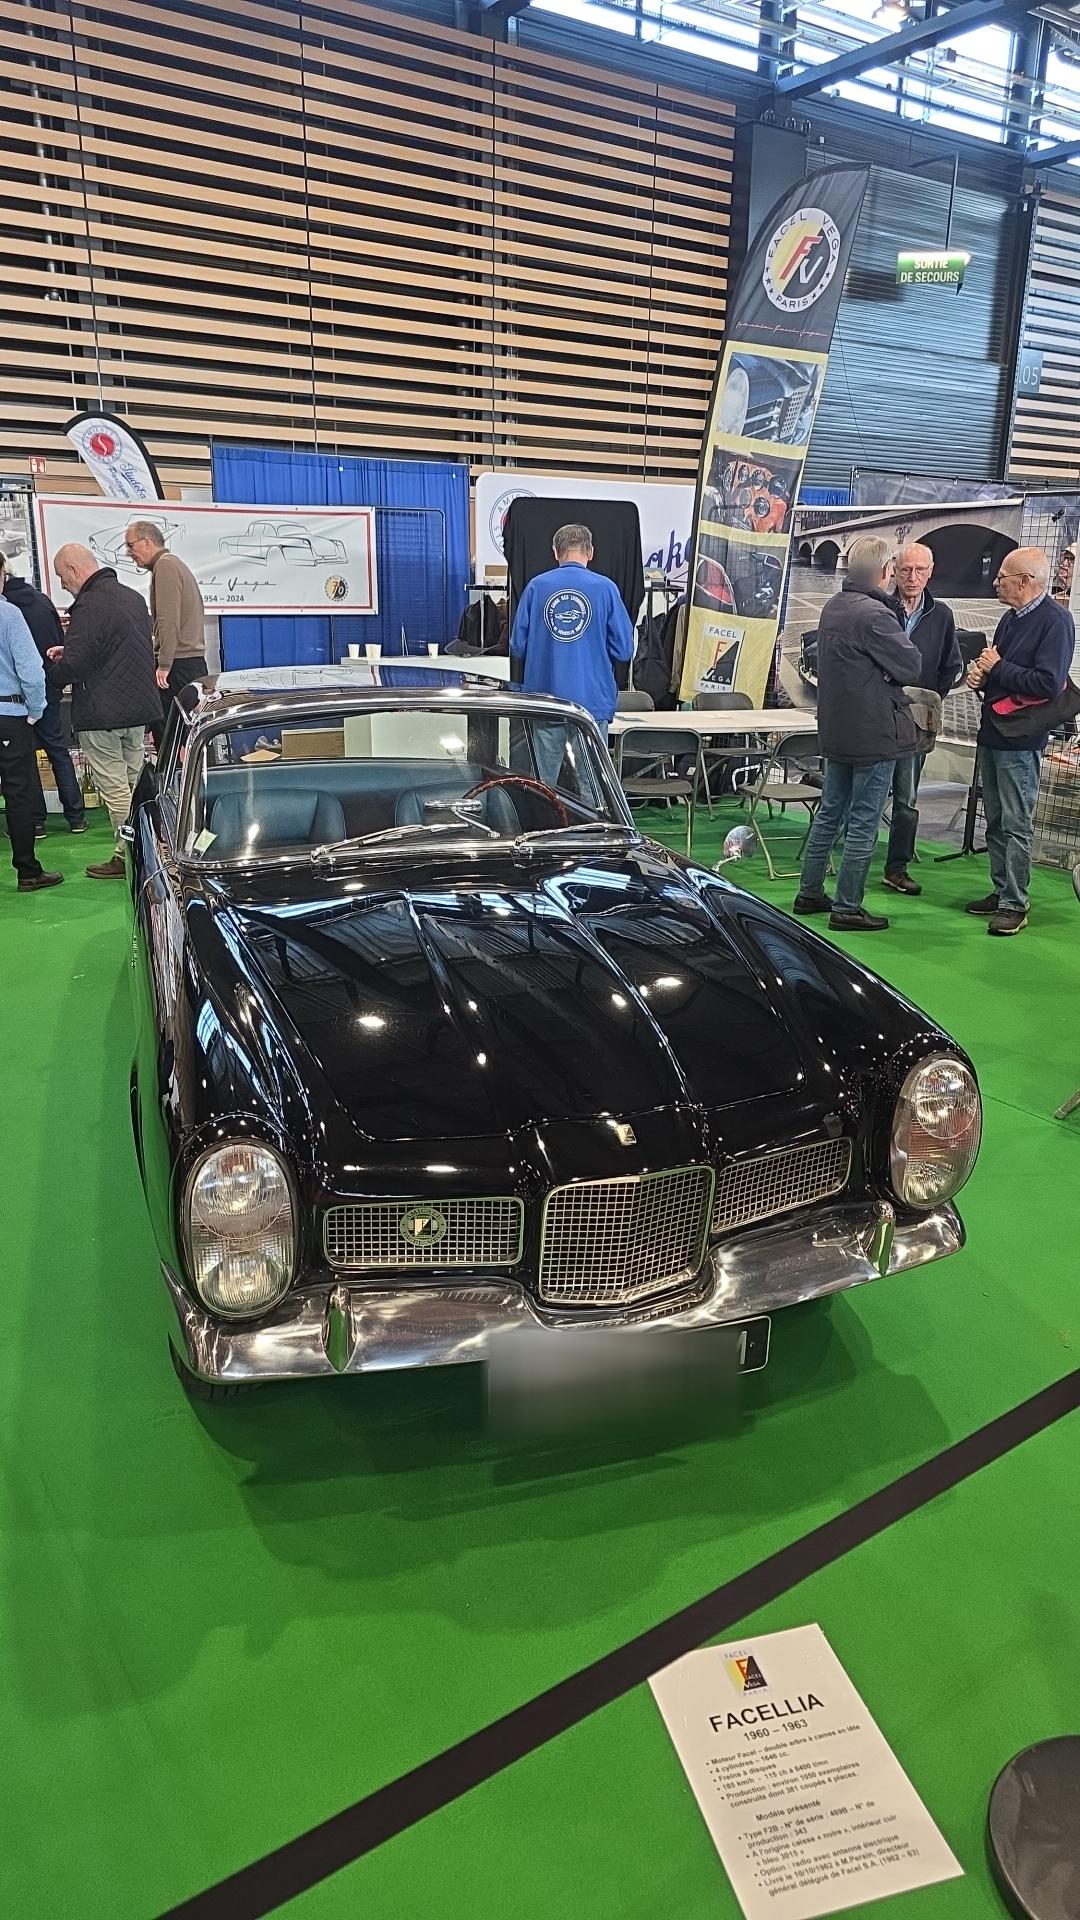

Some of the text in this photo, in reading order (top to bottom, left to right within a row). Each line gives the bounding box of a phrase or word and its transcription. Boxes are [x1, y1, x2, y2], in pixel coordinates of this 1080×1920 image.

[768, 211, 840, 265] FACEL VEGA
[914, 258, 949, 269] SORTIE
[901, 271, 960, 283] DE SECOURS
[776, 294, 809, 308] PARIS
[228, 576, 278, 592] Vega
[203, 594, 218, 603] 954
[226, 594, 245, 603] 2024
[709, 626, 737, 639] FACEL
[701, 682, 726, 691] PARIS
[724, 1650, 748, 1659] FACEL
[709, 1693, 825, 1733] FACELLIA
[743, 1727, 770, 1741] 1960
[781, 1719, 808, 1735] 1963
[710, 1755, 735, 1764] Moteur
[736, 1749, 756, 1758] Facel
[763, 1742, 787, 1752] double
[813, 1730, 836, 1739] cames
[717, 1772, 741, 1782] Freins
[748, 1763, 776, 1774] disques
[721, 1760, 753, 1772] cylindres
[722, 1781, 735, 1789] 185
[735, 1777, 754, 1786] km/h
[764, 1771, 777, 1779] 115
[778, 1768, 787, 1776] ch
[725, 1785, 766, 1799] Production
[771, 1777, 798, 1787] environ
[818, 1762, 859, 1776] exemplaires
[730, 1794, 766, 1807] construits
[767, 1788, 785, 1798] dont
[799, 1779, 826, 1790] coupés
[832, 1771, 858, 1782] places.
[755, 1799, 820, 1820] Modèle présenté
[742, 1830, 762, 1839] Type
[762, 1824, 778, 1834] F2B
[805, 1814, 823, 1823] série
[791, 1836, 815, 1847] caisse
[822, 1829, 842, 1839] noire
[850, 1818, 881, 1831] intérieur
[882, 1814, 896, 1823] cuir
[747, 1833, 788, 1849] production
[759, 1864, 786, 1876] Option
[791, 1858, 811, 1867] radio
[812, 1853, 830, 1861] avec
[831, 1844, 861, 1856] antenne
[862, 1834, 899, 1848] électrique
[761, 1856, 779, 1865] bleu
[763, 1875, 783, 1886] Livré
[876, 1841, 912, 1858] directeur
[768, 1882, 797, 1896] général
[798, 1874, 828, 1887] délégué
[840, 1864, 861, 1875] Facel
[862, 1860, 879, 1869] S.A.
[879, 1854, 900, 1865] (1962
